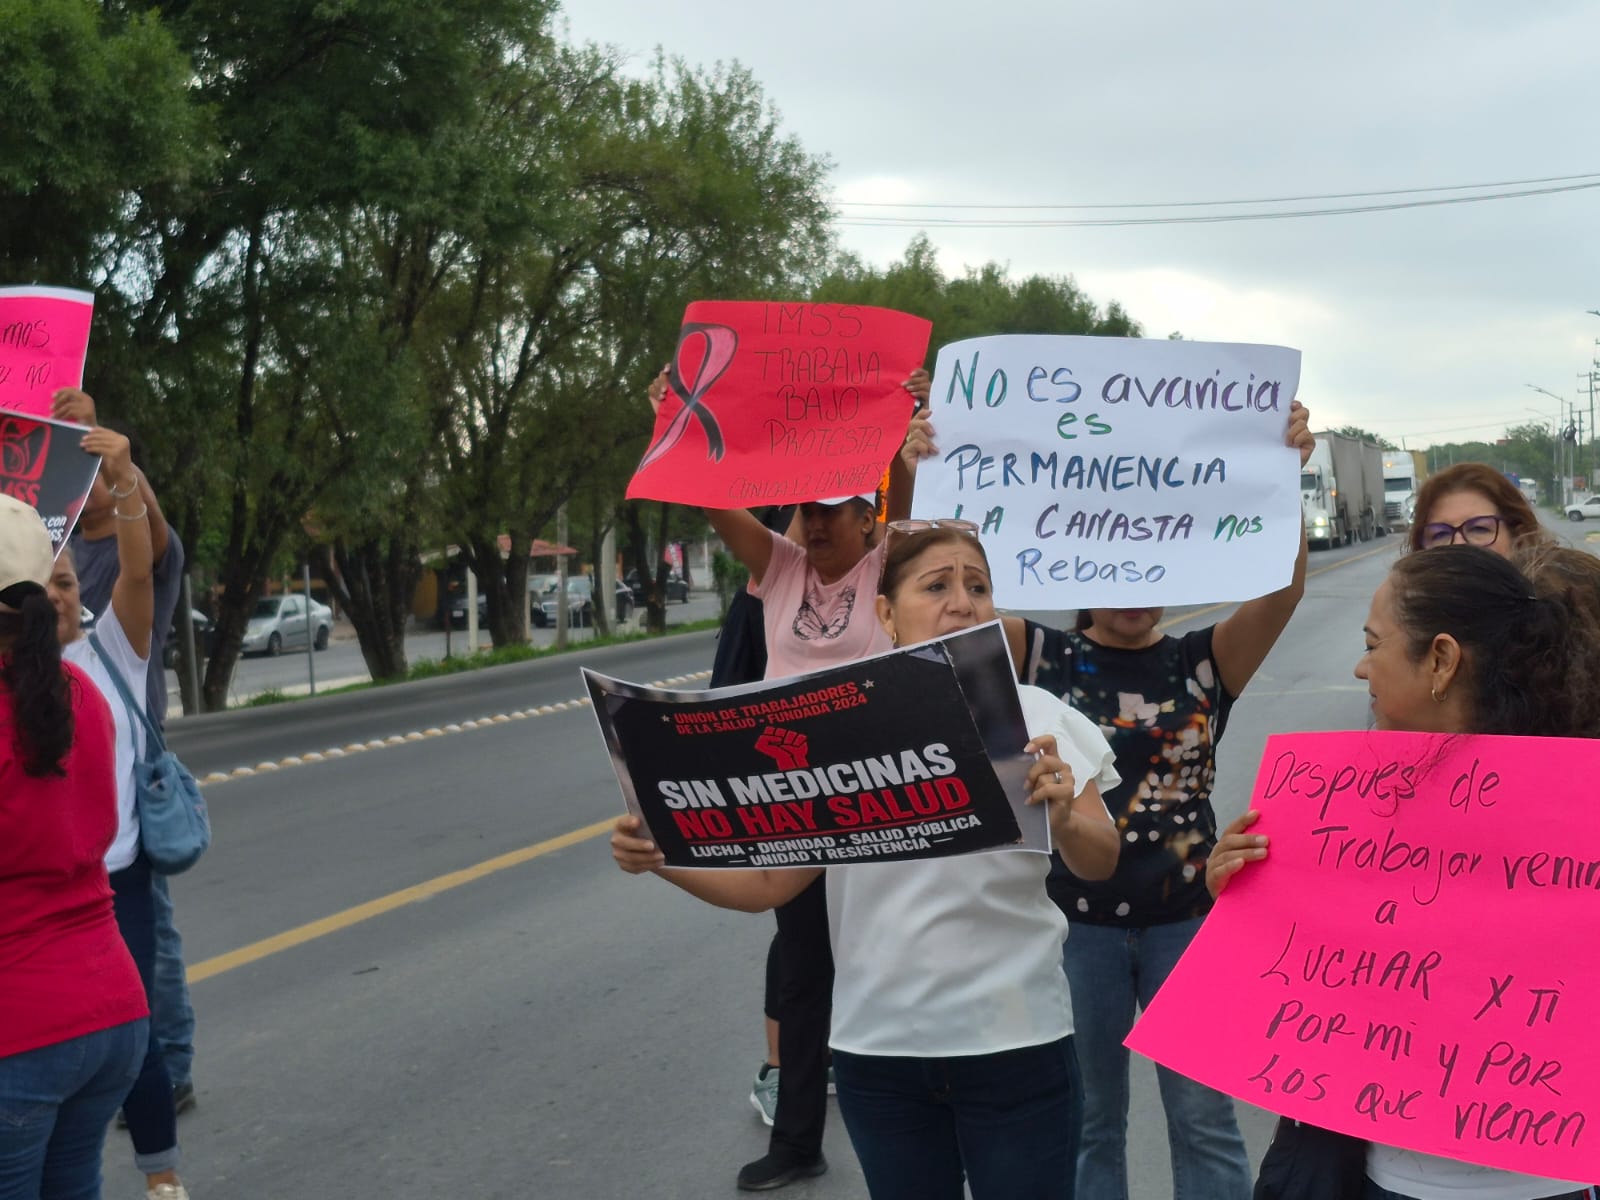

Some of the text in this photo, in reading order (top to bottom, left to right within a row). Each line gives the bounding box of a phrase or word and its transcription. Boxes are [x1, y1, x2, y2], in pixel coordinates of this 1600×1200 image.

[763, 303, 863, 338] IMSS
[753, 346, 881, 385] TRABAJA
[777, 384, 860, 422] BAJO
[1026, 366, 1083, 404] es
[1101, 368, 1282, 413] avaricia
[763, 418, 882, 457] PROTESTA
[1056, 411, 1113, 440] es
[944, 443, 1227, 492] PERMANENCIA
[1034, 502, 1195, 543] CANASTA
[1213, 513, 1264, 543] nos
[1016, 547, 1167, 586] Rebaso
[676, 693, 868, 735] DE LA SALUD FUNDADA 2024
[720, 709, 740, 721] DE
[740, 681, 859, 717] TRABAJADORES
[657, 742, 957, 810] SIN MEDICINAS
[1449, 757, 1501, 814] de
[671, 776, 972, 840] NO HAY SALUD
[690, 814, 983, 858] LUCHA DIGNIDAD SALUD PÚBLICA
[750, 851, 812, 867] UNIDAD
[812, 849, 824, 861] Y
[1311, 827, 1482, 905] Trabajar
[1375, 900, 1399, 926] a
[1260, 921, 1442, 1001] LUCHAR
[1265, 1000, 1356, 1044] POR
[1475, 1041, 1562, 1097] POR
[1454, 1100, 1587, 1149] vienen
